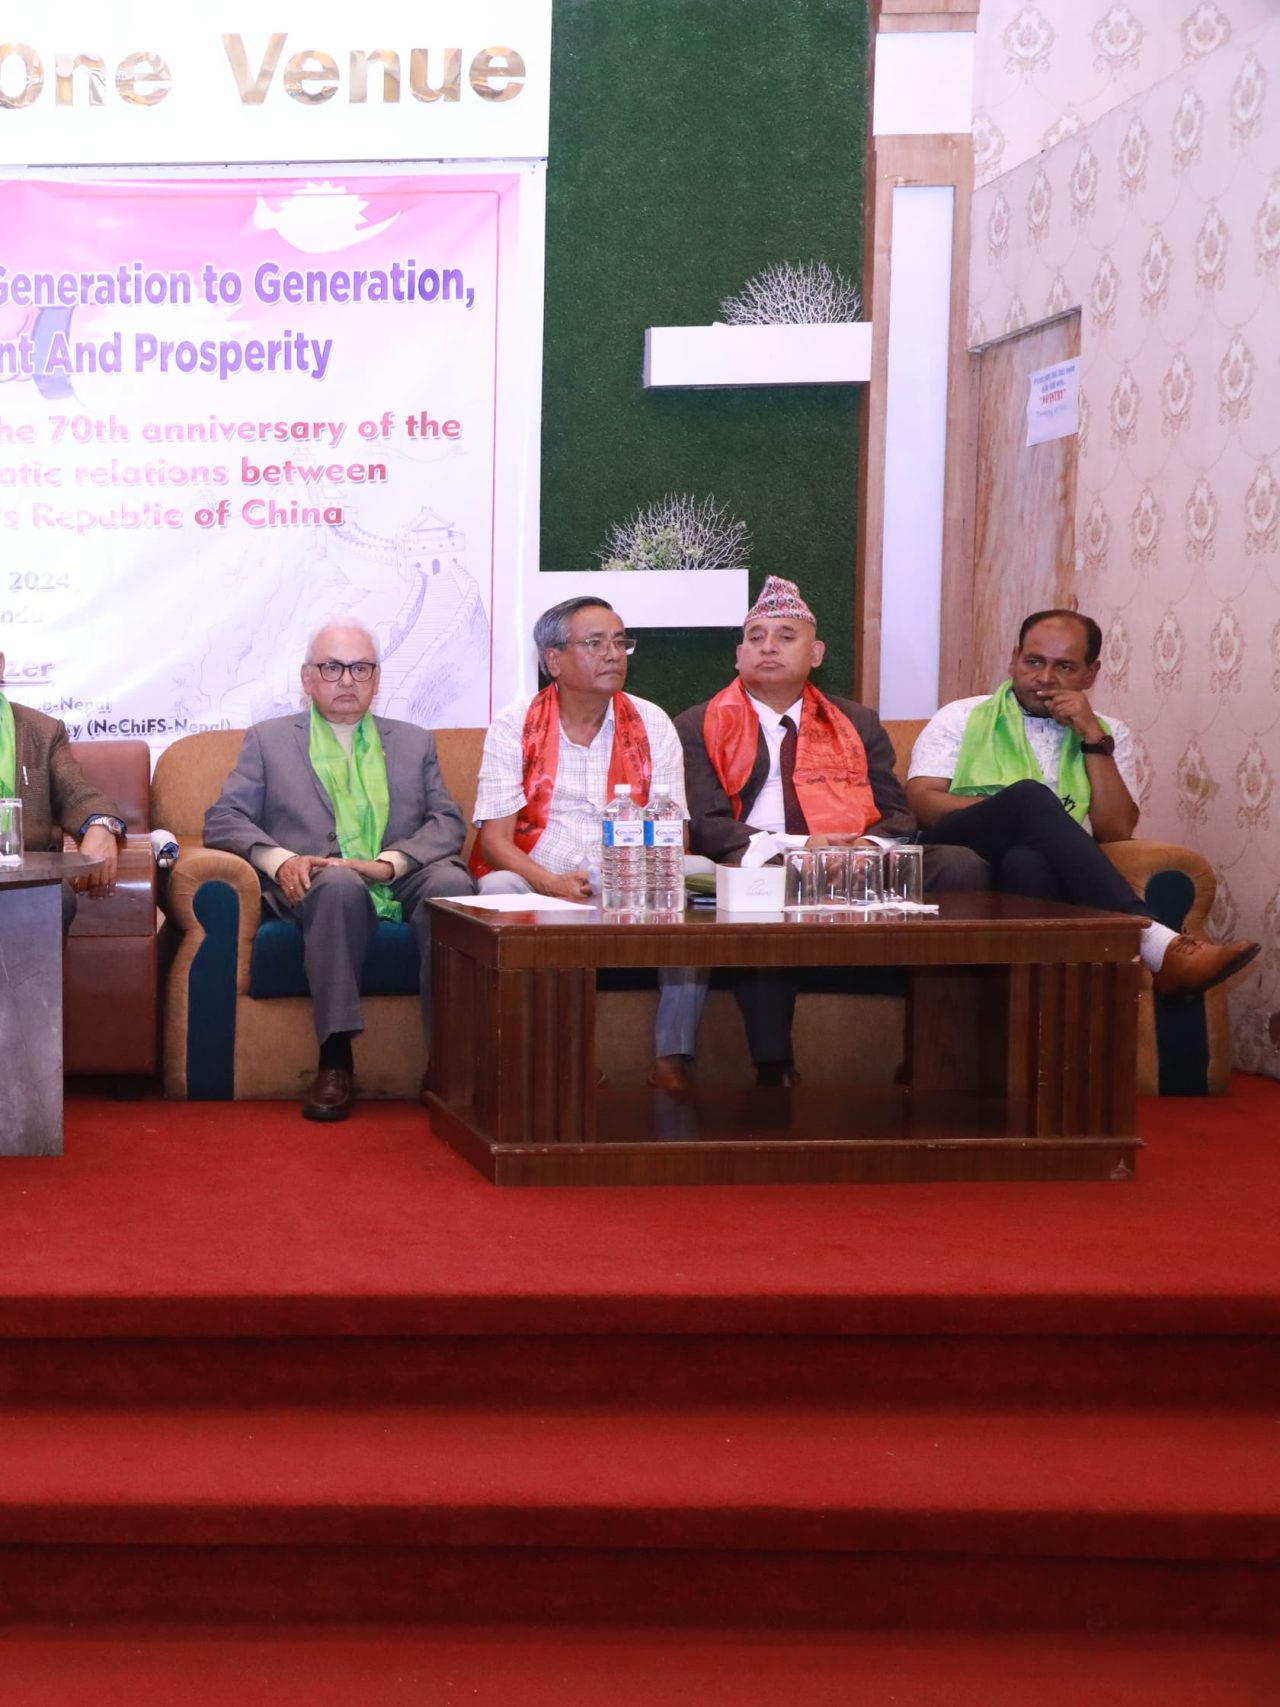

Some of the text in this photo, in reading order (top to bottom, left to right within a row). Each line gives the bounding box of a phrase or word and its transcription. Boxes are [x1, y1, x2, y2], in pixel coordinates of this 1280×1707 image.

[221, 32, 527, 105] Venue
[203, 264, 242, 305] to
[254, 259, 475, 309] Generation,
[45, 331, 122, 374] And
[134, 329, 333, 381] Prosperity
[48, 414, 129, 442] 70th
[141, 414, 346, 447] anniversary
[357, 411, 394, 438] of
[405, 410, 462, 438] the
[74, 457, 229, 485] relations
[241, 456, 388, 484] between
[31, 501, 184, 536] Republic
[194, 499, 230, 527] of
[241, 498, 344, 527] China
[7, 569, 70, 591] 2024
